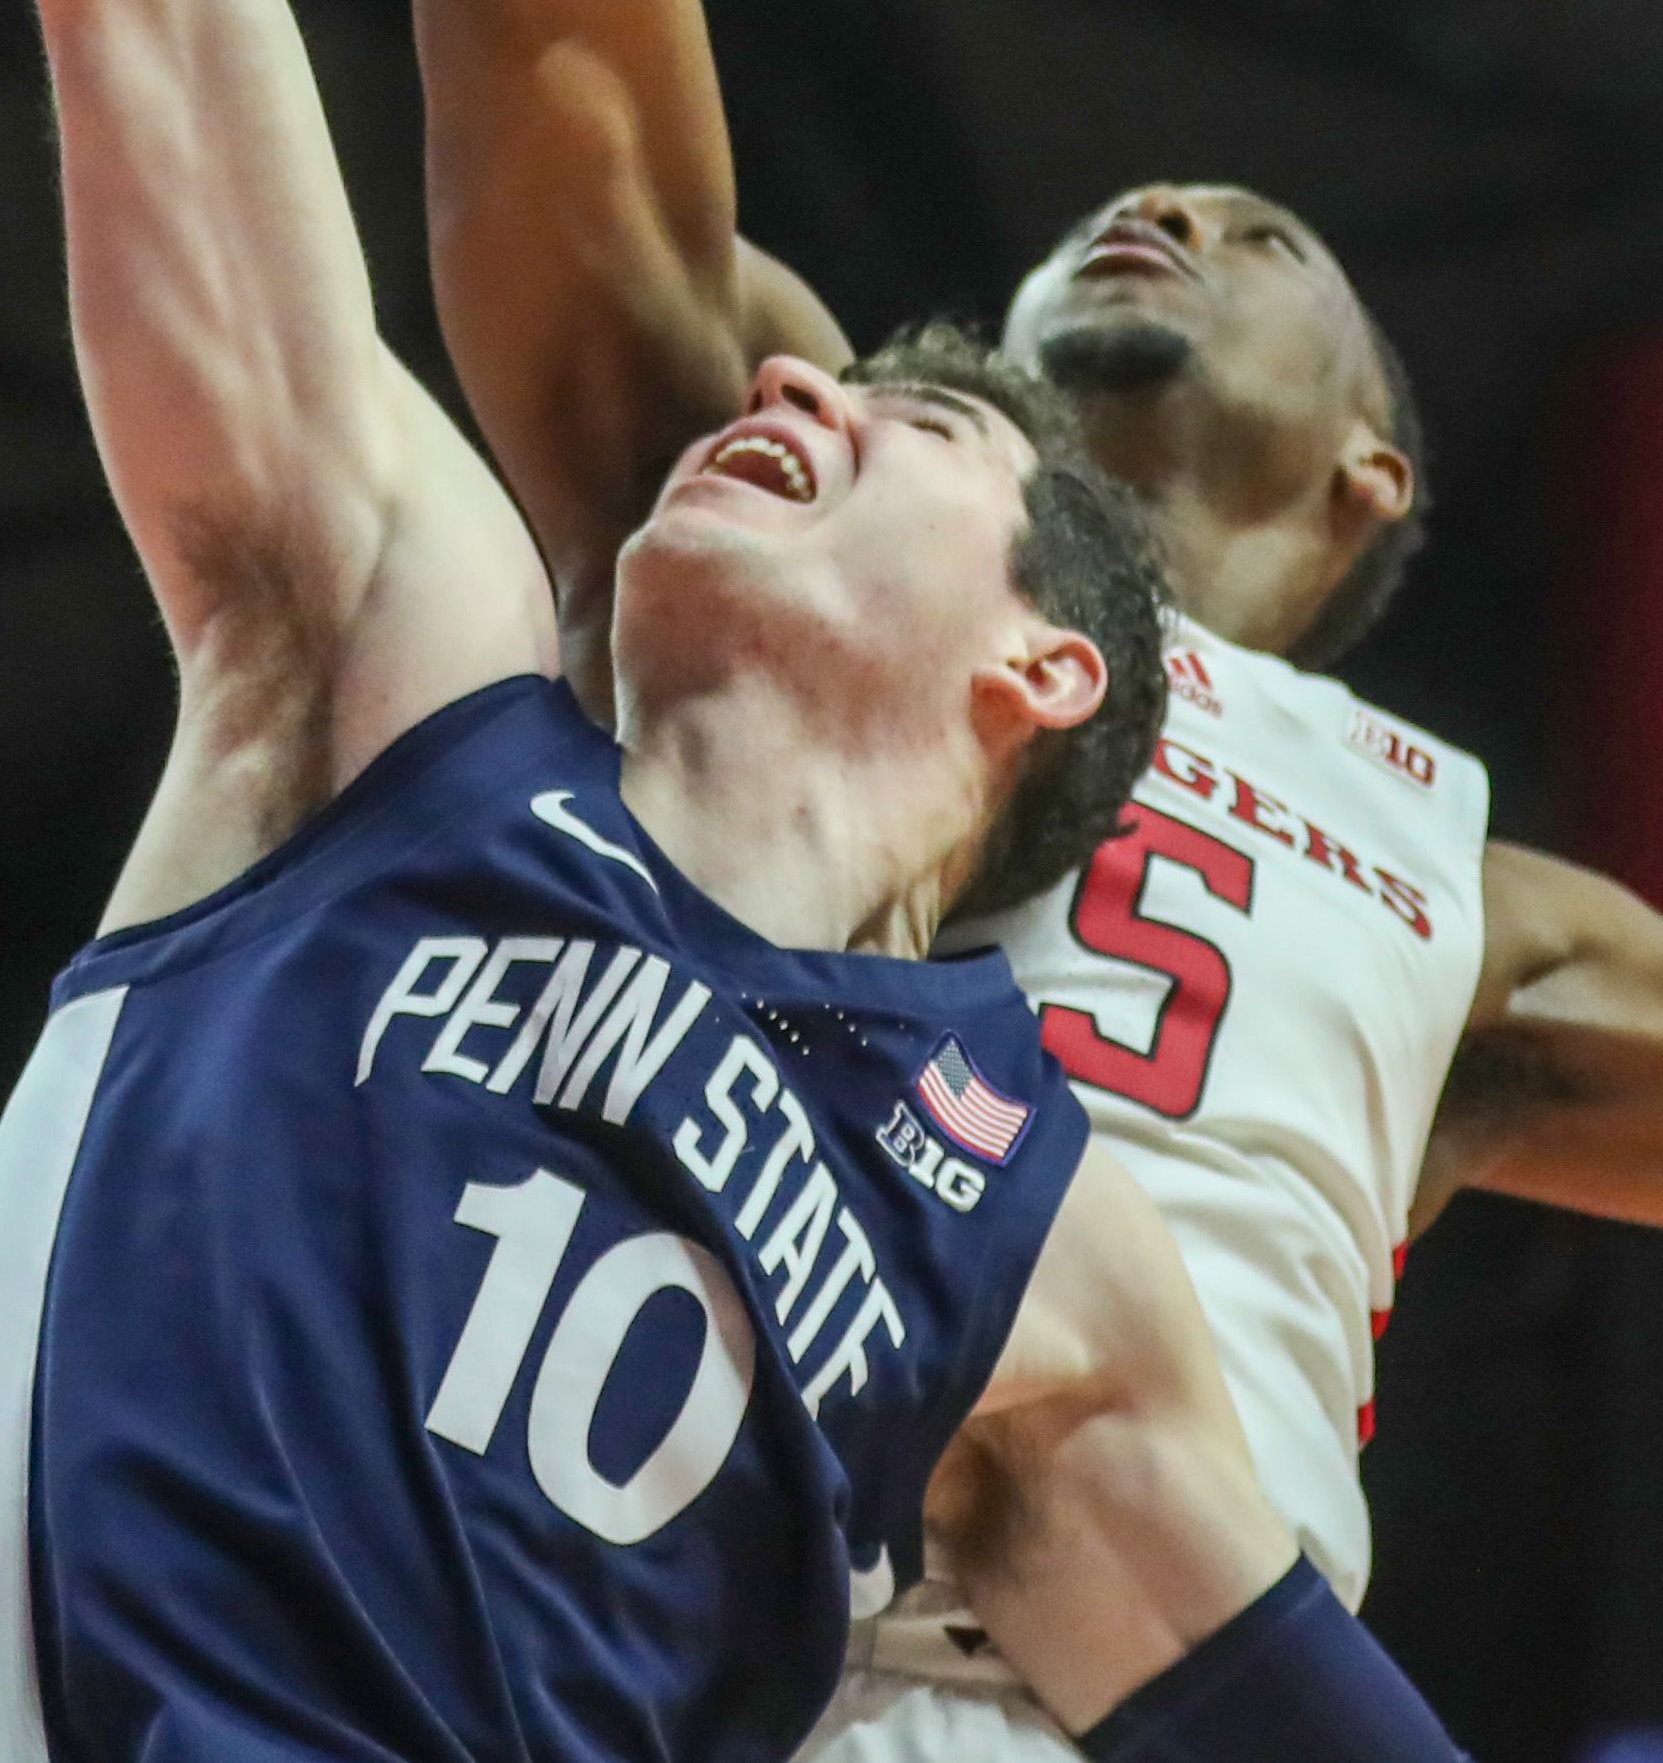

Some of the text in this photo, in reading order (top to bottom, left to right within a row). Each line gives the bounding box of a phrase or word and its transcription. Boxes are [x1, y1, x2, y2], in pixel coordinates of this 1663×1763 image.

[1038, 800, 1256, 1123] 5
[354, 935, 907, 1424] PENN STATE
[423, 1167, 756, 1546] 10
